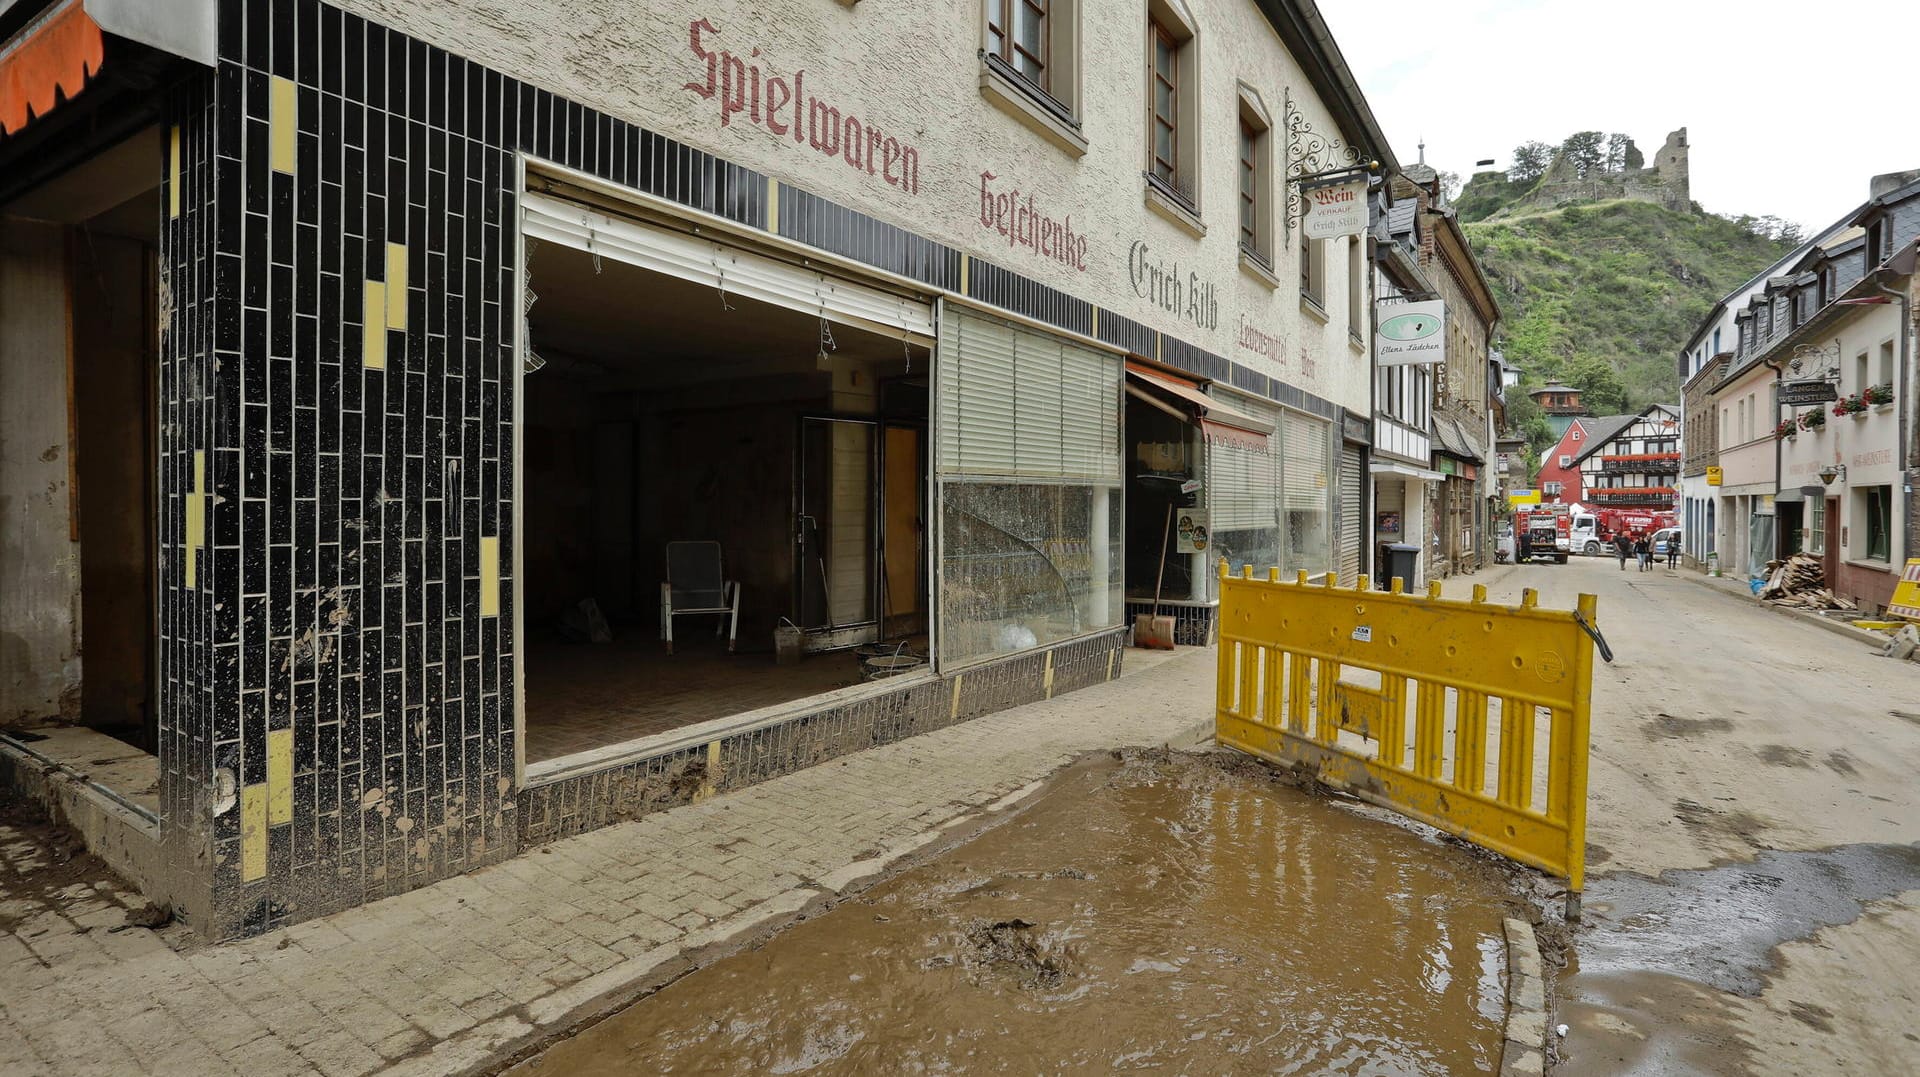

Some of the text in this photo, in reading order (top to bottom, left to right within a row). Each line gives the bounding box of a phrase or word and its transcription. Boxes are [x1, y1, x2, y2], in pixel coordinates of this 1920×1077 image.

[682, 17, 920, 196] Spielwaren
[1315, 188, 1354, 205] Wein
[1317, 207, 1350, 216] VERKAUF
[1128, 239, 1219, 332] Erich Kilb
[1238, 313, 1287, 366] Lebensmittel
[1380, 343, 1440, 355] Ellens Lädchen
